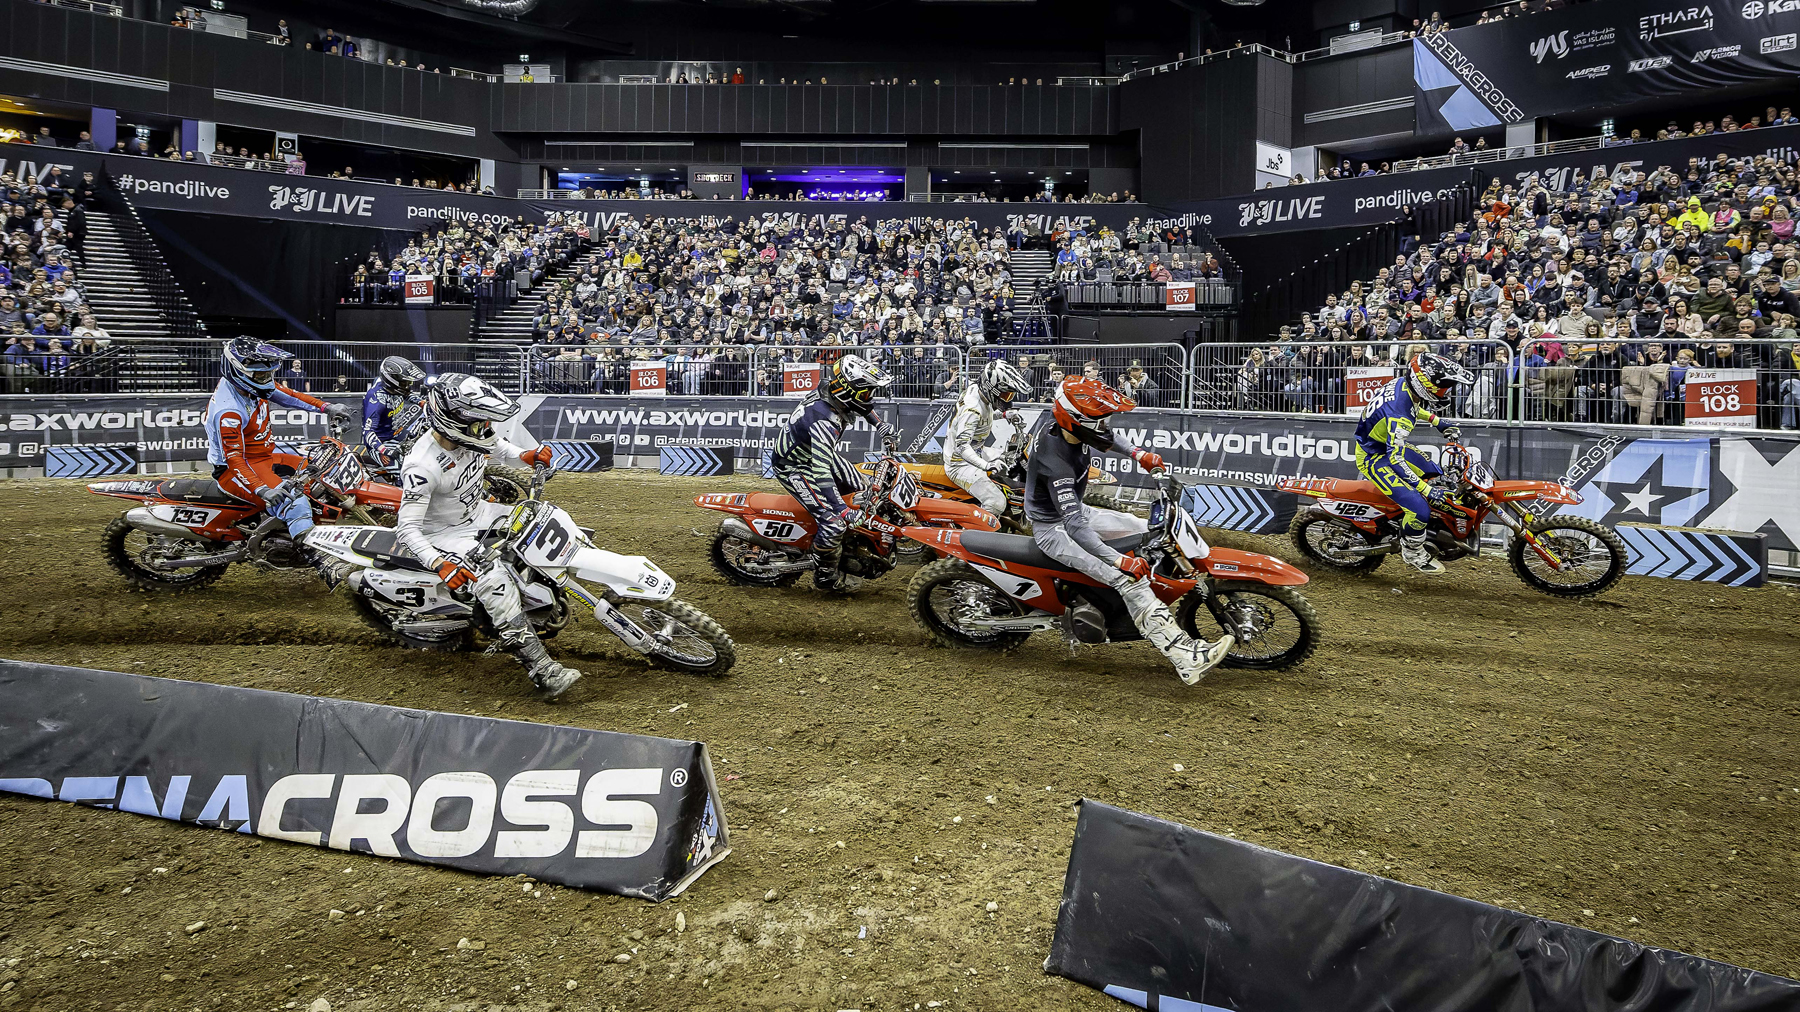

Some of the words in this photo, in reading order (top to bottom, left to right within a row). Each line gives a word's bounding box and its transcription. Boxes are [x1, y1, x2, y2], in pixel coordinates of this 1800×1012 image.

[1640, 5, 1713, 30] ETHARA
[1573, 38, 1587, 46] YAS
[1589, 33, 1615, 43] ISLAND
[1711, 44, 1741, 54] ARMOR
[1711, 51, 1739, 60] VISION
[1565, 64, 1611, 78] AMPED
[1266, 157, 1280, 171] Jbs
[119, 173, 230, 199] #pandjlive
[269, 185, 317, 213] P&J
[318, 193, 375, 217] LIVE
[1239, 200, 1277, 227] P&J
[1276, 196, 1325, 222] LIVE
[411, 287, 428, 296] 105
[1172, 294, 1190, 303] 107
[637, 376, 659, 388] 106
[791, 371, 811, 379] BLOCK
[791, 378, 812, 389] 106
[837, 374, 856, 395] LEATT
[1357, 380, 1382, 389] BLOCK
[1700, 384, 1739, 395] BLOCK
[1699, 394, 1741, 413] 108
[333, 454, 361, 493] 133
[1377, 466, 1404, 488] FLY
[898, 475, 917, 508] 50
[171, 507, 210, 523] 133
[763, 509, 795, 518] HONDA
[1335, 502, 1371, 516] 426
[764, 521, 795, 538] 50
[865, 517, 896, 533] APICO
[535, 517, 569, 562] 3
[1013, 582, 1034, 597] 1
[395, 587, 426, 608] 3
